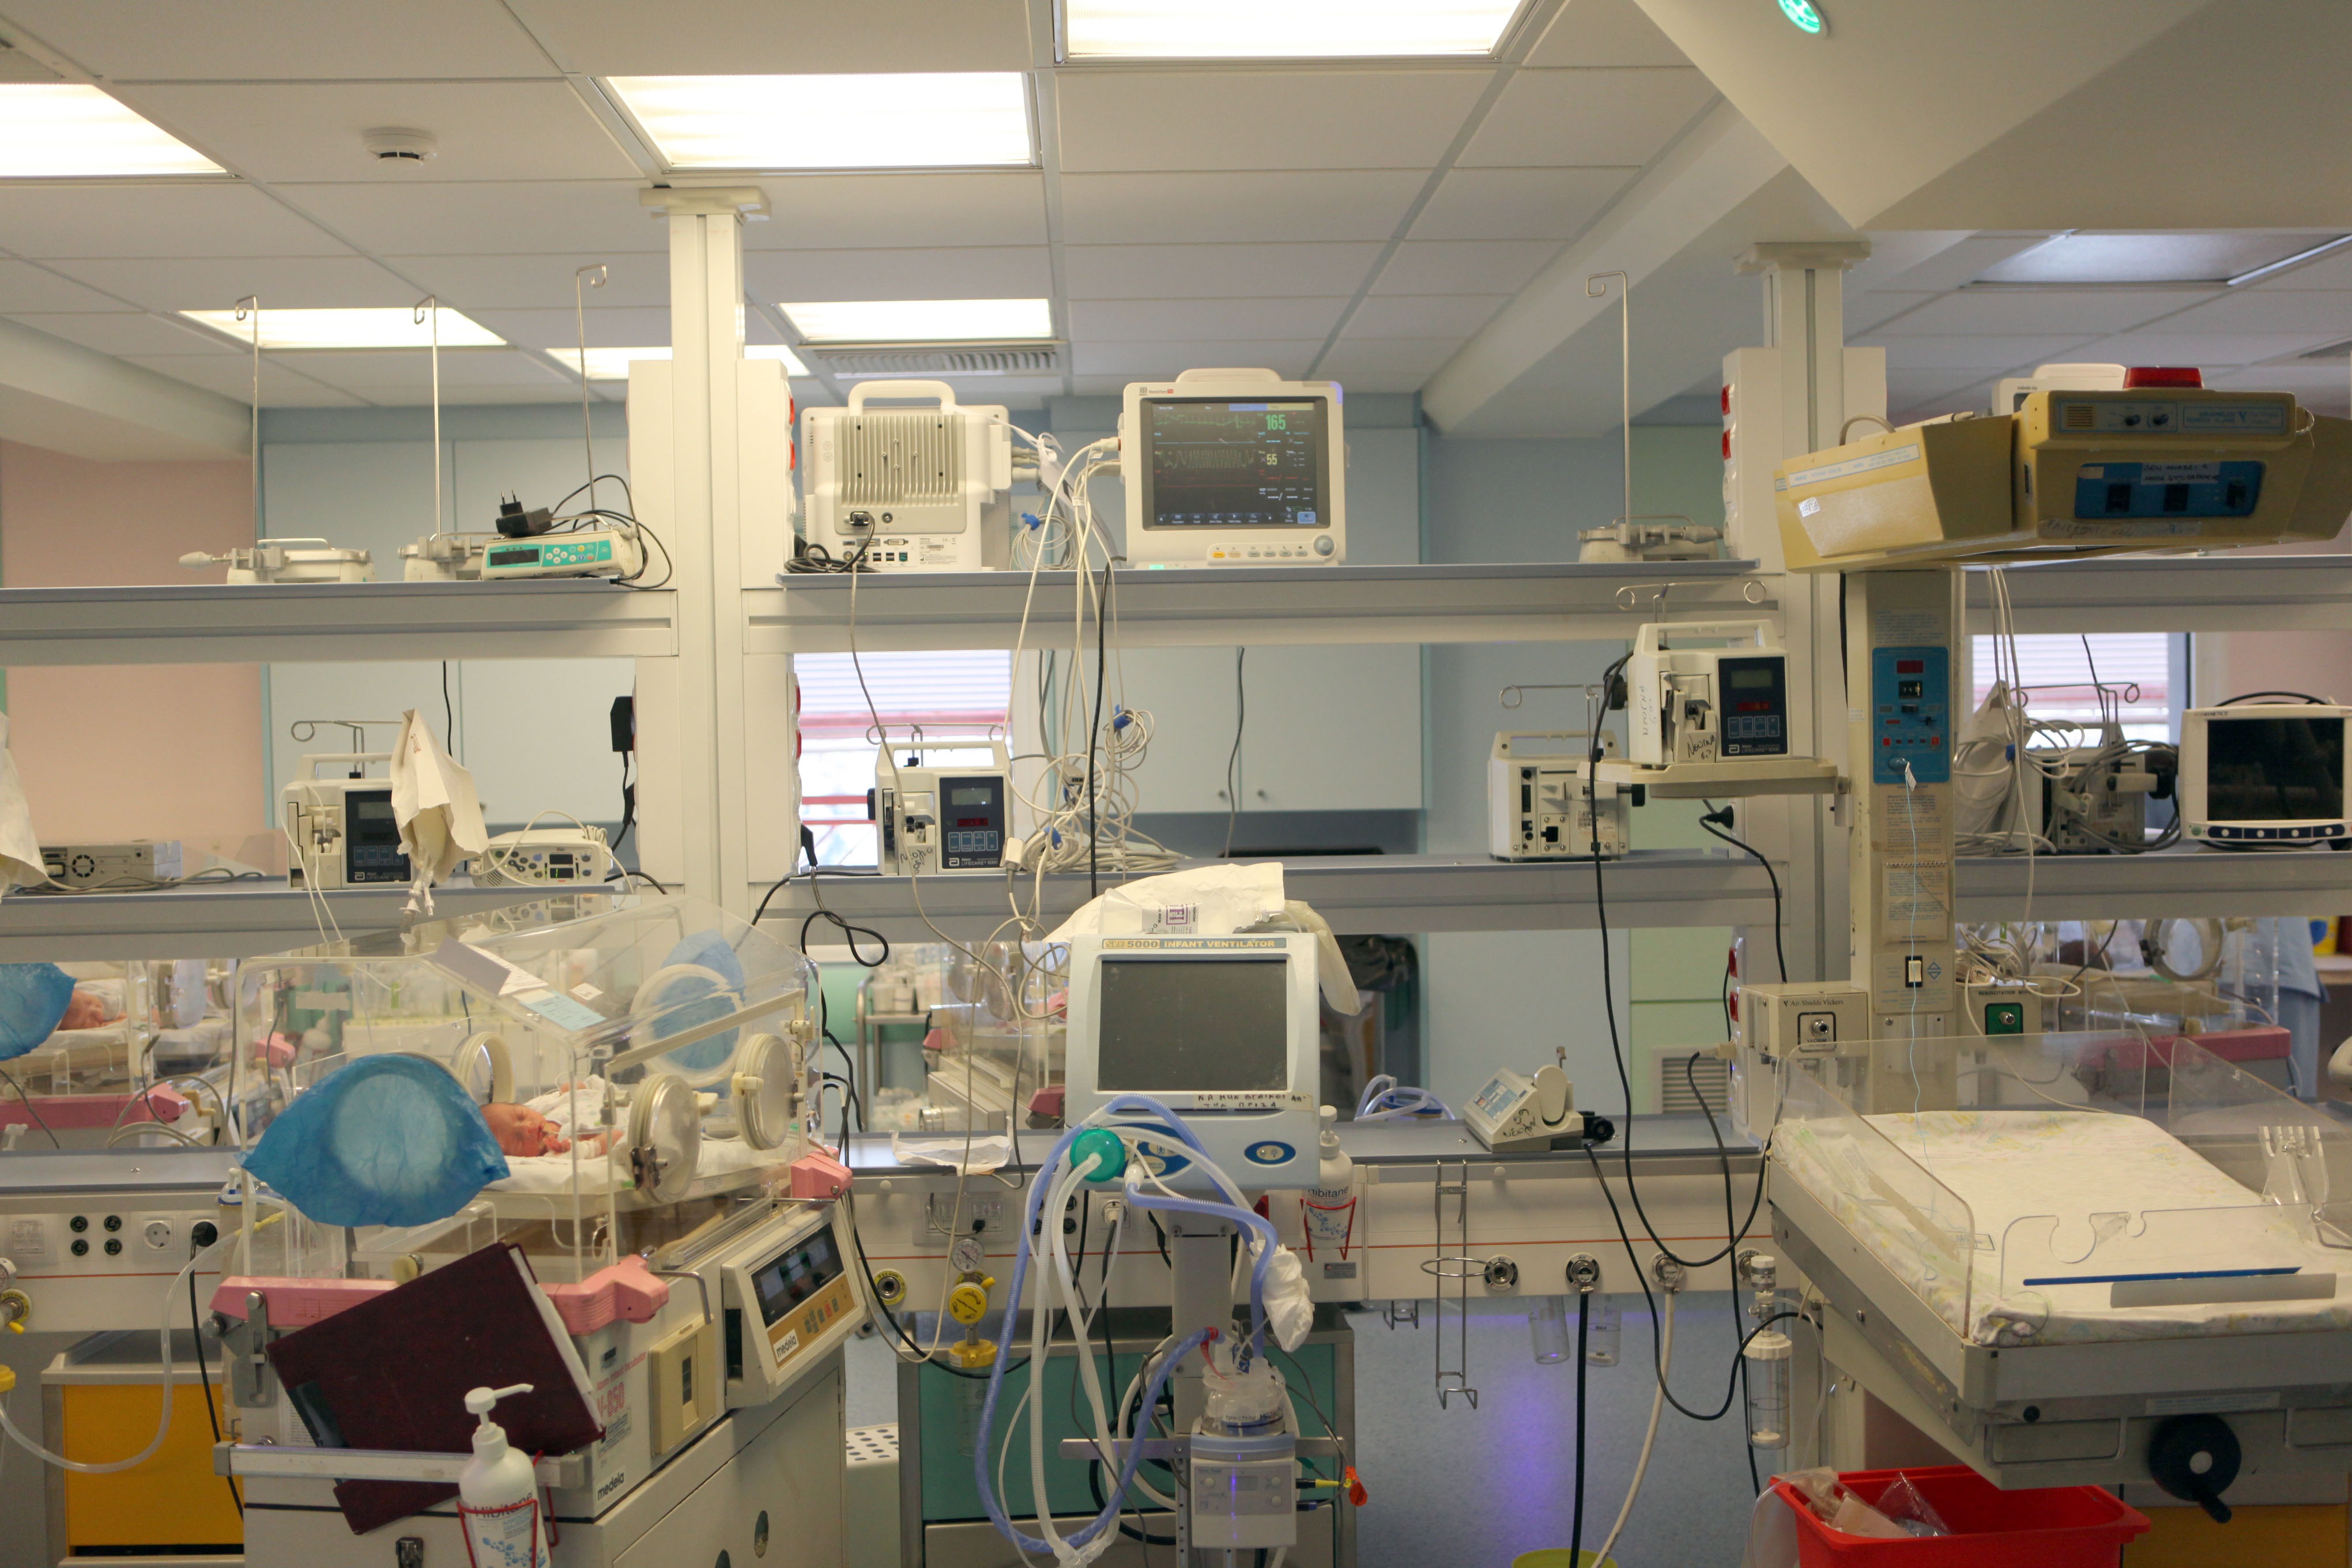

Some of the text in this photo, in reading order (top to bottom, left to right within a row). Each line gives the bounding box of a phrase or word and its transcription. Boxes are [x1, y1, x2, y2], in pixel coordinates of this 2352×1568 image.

[1265, 414, 1286, 430] 165
[1267, 453, 1277, 465] 55
[1207, 940, 1276, 948] VENTILATOR
[776, 1335, 797, 1359] medela
[597, 1472, 624, 1501] medela
